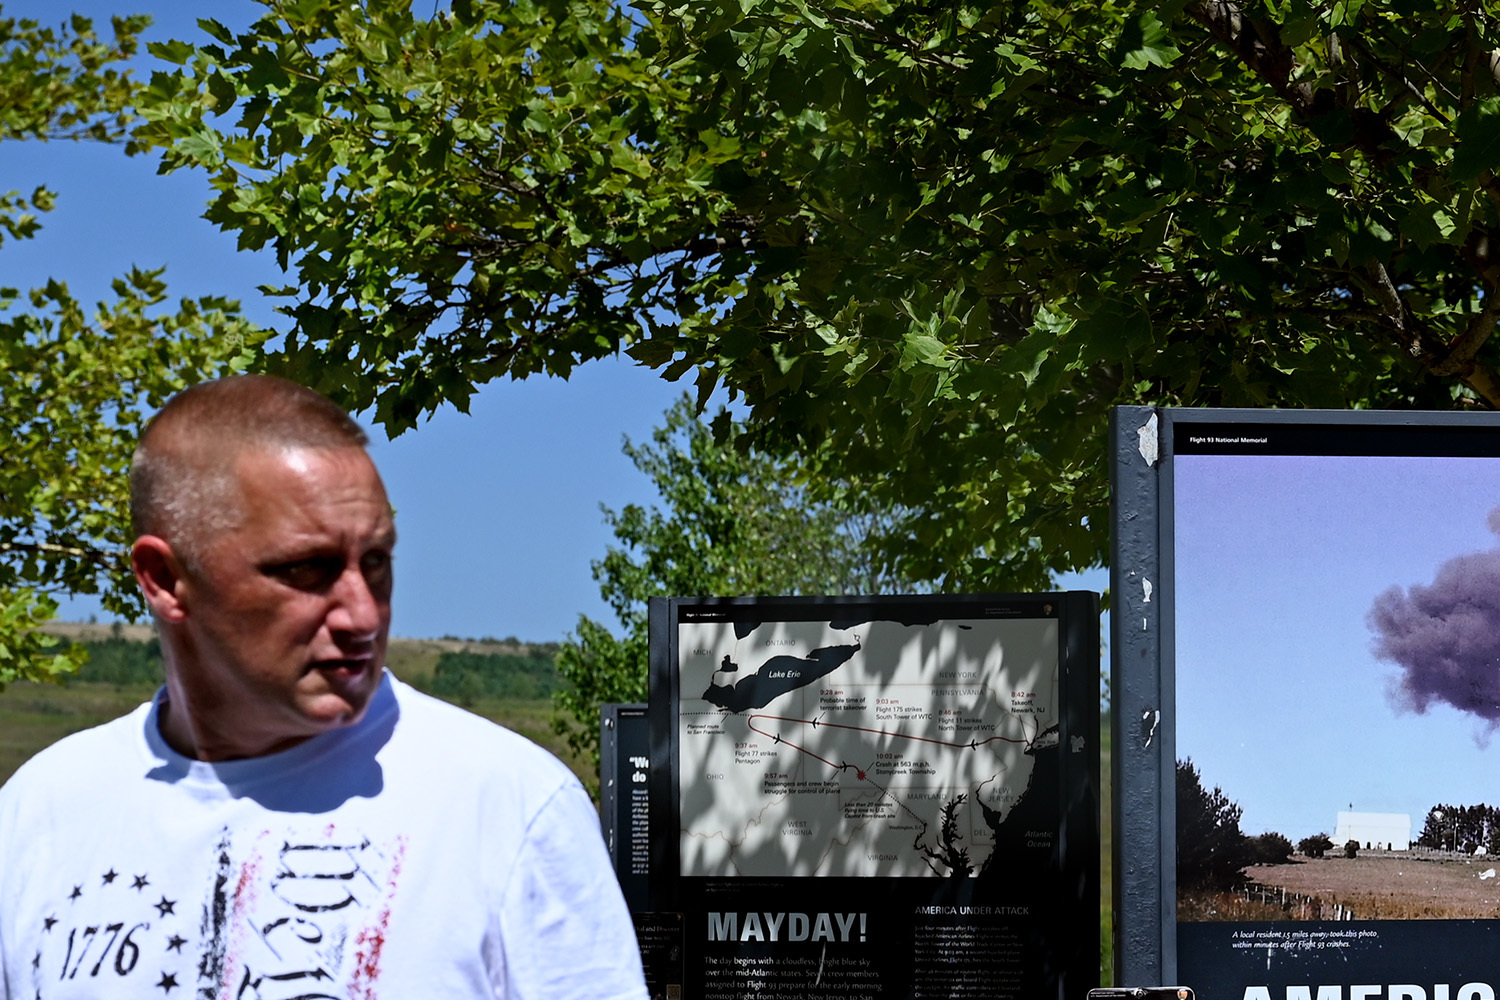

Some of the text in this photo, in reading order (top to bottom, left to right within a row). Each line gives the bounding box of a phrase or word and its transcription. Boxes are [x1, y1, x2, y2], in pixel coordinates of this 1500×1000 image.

[768, 670, 785, 678] Lake
[632, 771, 646, 782] do
[248, 837, 383, 963] We
[915, 906, 1028, 914] AMERICA UNDER ATTACK
[708, 912, 867, 942] MAYDAY!
[59, 922, 151, 981] 1776
